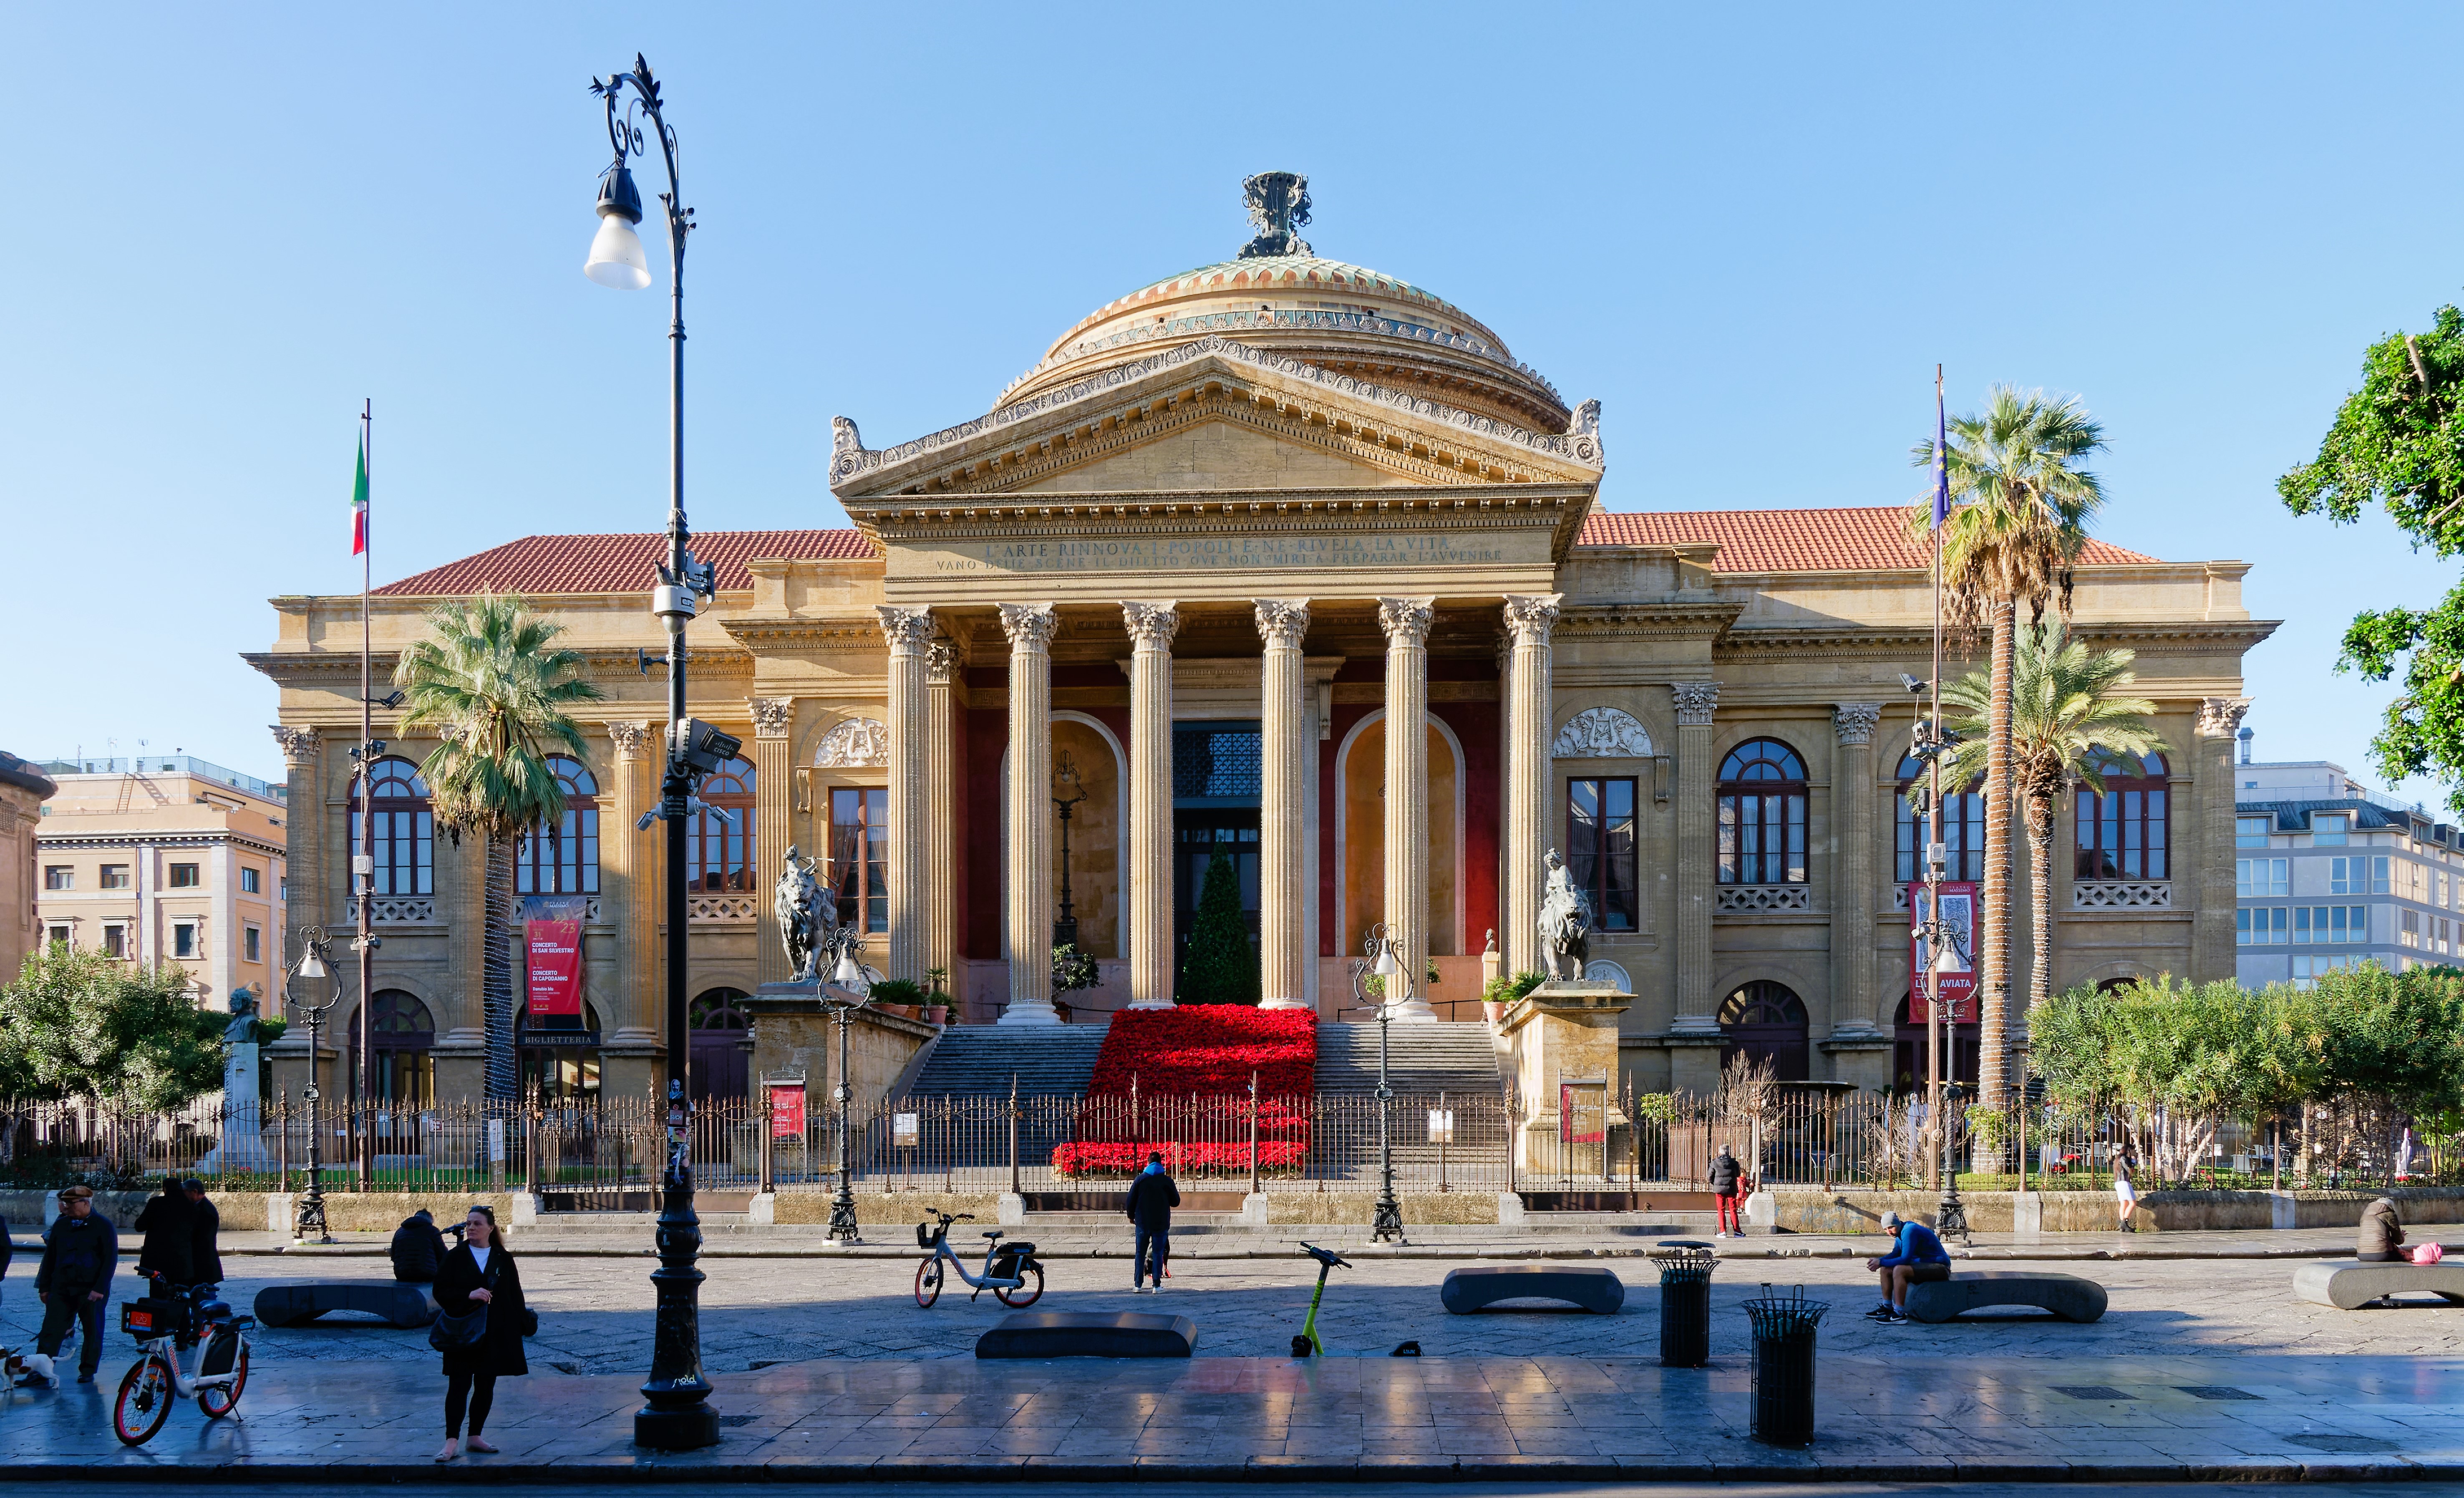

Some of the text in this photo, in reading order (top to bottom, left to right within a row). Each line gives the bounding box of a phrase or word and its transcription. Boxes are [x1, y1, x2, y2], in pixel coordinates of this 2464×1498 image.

[985, 536, 1449, 557] L'ARTE RINNOVA I POPOLI E NE RIVELA LA VITA
[937, 560, 977, 570] VANO
[1036, 558, 1085, 568] SCENE
[1096, 557, 1109, 567] IL
[1229, 554, 1260, 565] NON
[1274, 553, 1306, 564] MIRI
[1316, 553, 1323, 563] A
[1333, 552, 1408, 564] PREPARAR
[1419, 550, 1502, 561] L'AVVENIRE
[561, 923, 575, 933] 23
